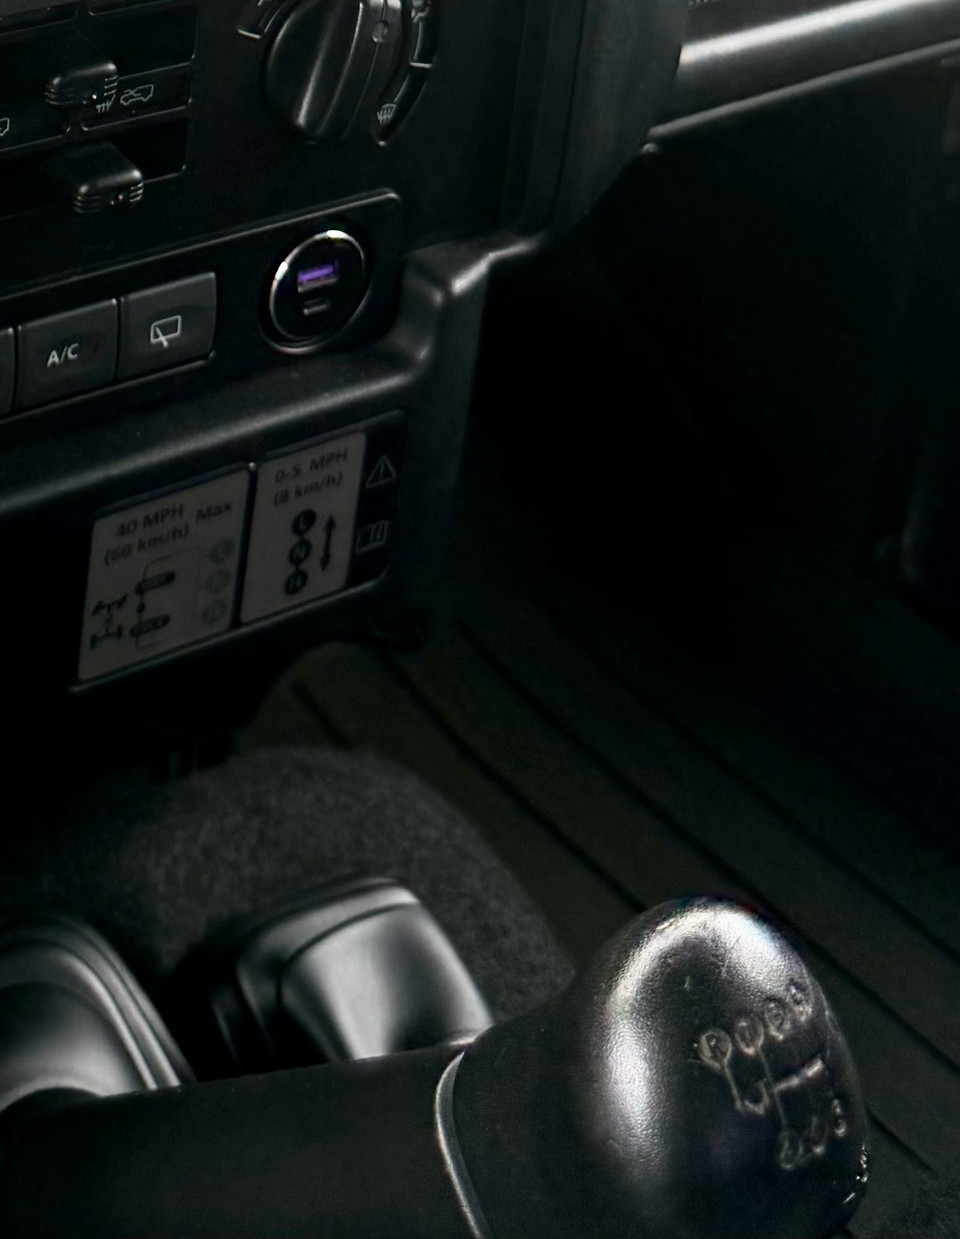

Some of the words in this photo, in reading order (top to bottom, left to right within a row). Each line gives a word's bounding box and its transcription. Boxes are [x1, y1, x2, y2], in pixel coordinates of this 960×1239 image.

[46, 343, 80, 369] A/C
[274, 463, 301, 484] 0-5
[309, 449, 349, 472] MPH
[294, 471, 344, 499] km/h)
[116, 519, 138, 537] 40
[142, 503, 184, 529] MPH
[195, 502, 233, 522] Max
[137, 524, 191, 552] km/h)
